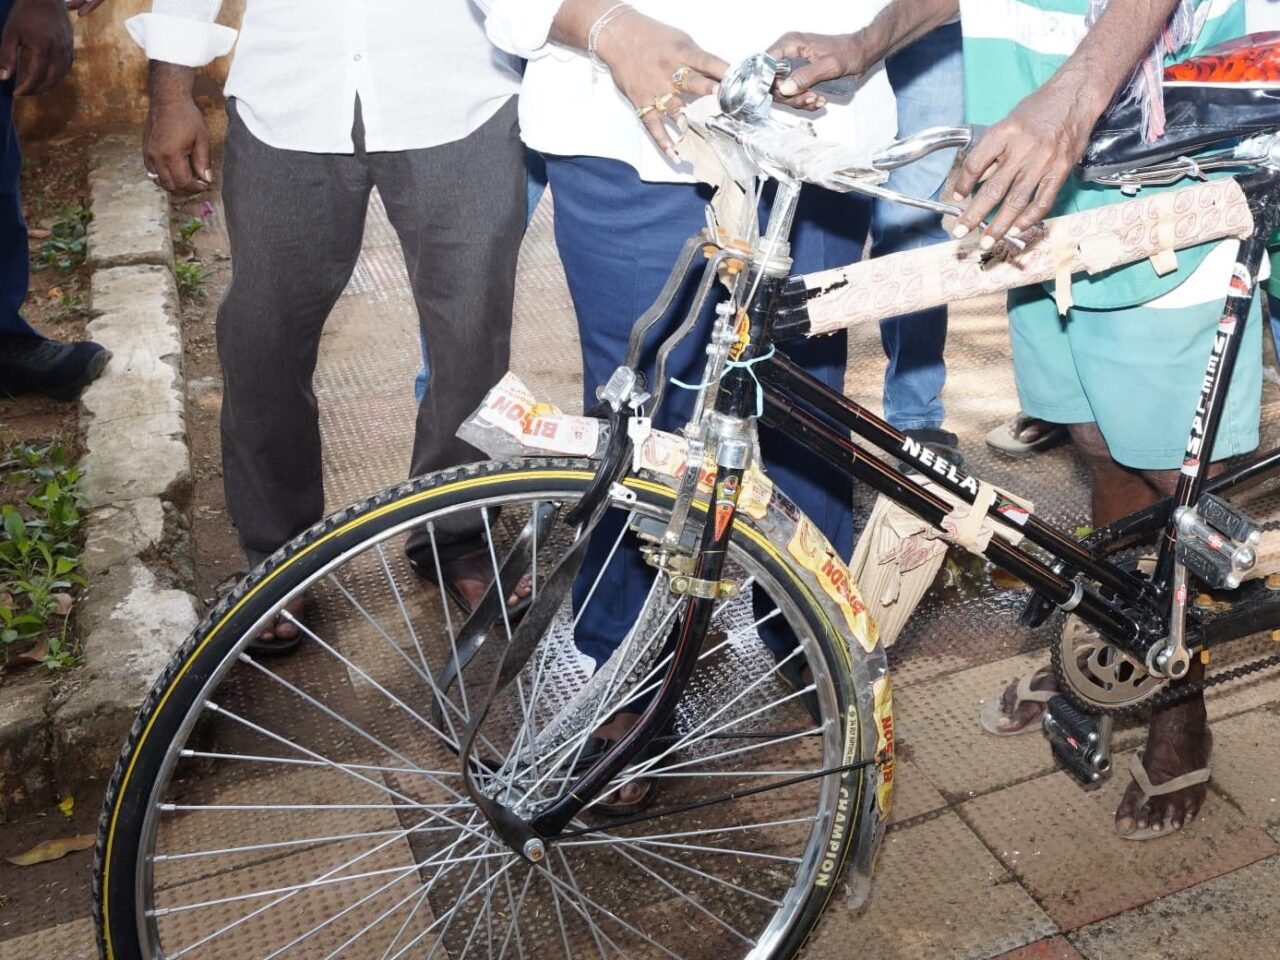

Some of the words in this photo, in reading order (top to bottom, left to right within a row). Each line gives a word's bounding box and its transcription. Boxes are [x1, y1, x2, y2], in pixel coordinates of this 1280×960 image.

[1187, 335, 1226, 455] NEELAM
[902, 436, 997, 506] NEELA
[881, 714, 894, 784] BISON
[815, 788, 850, 887] CHAMPION
